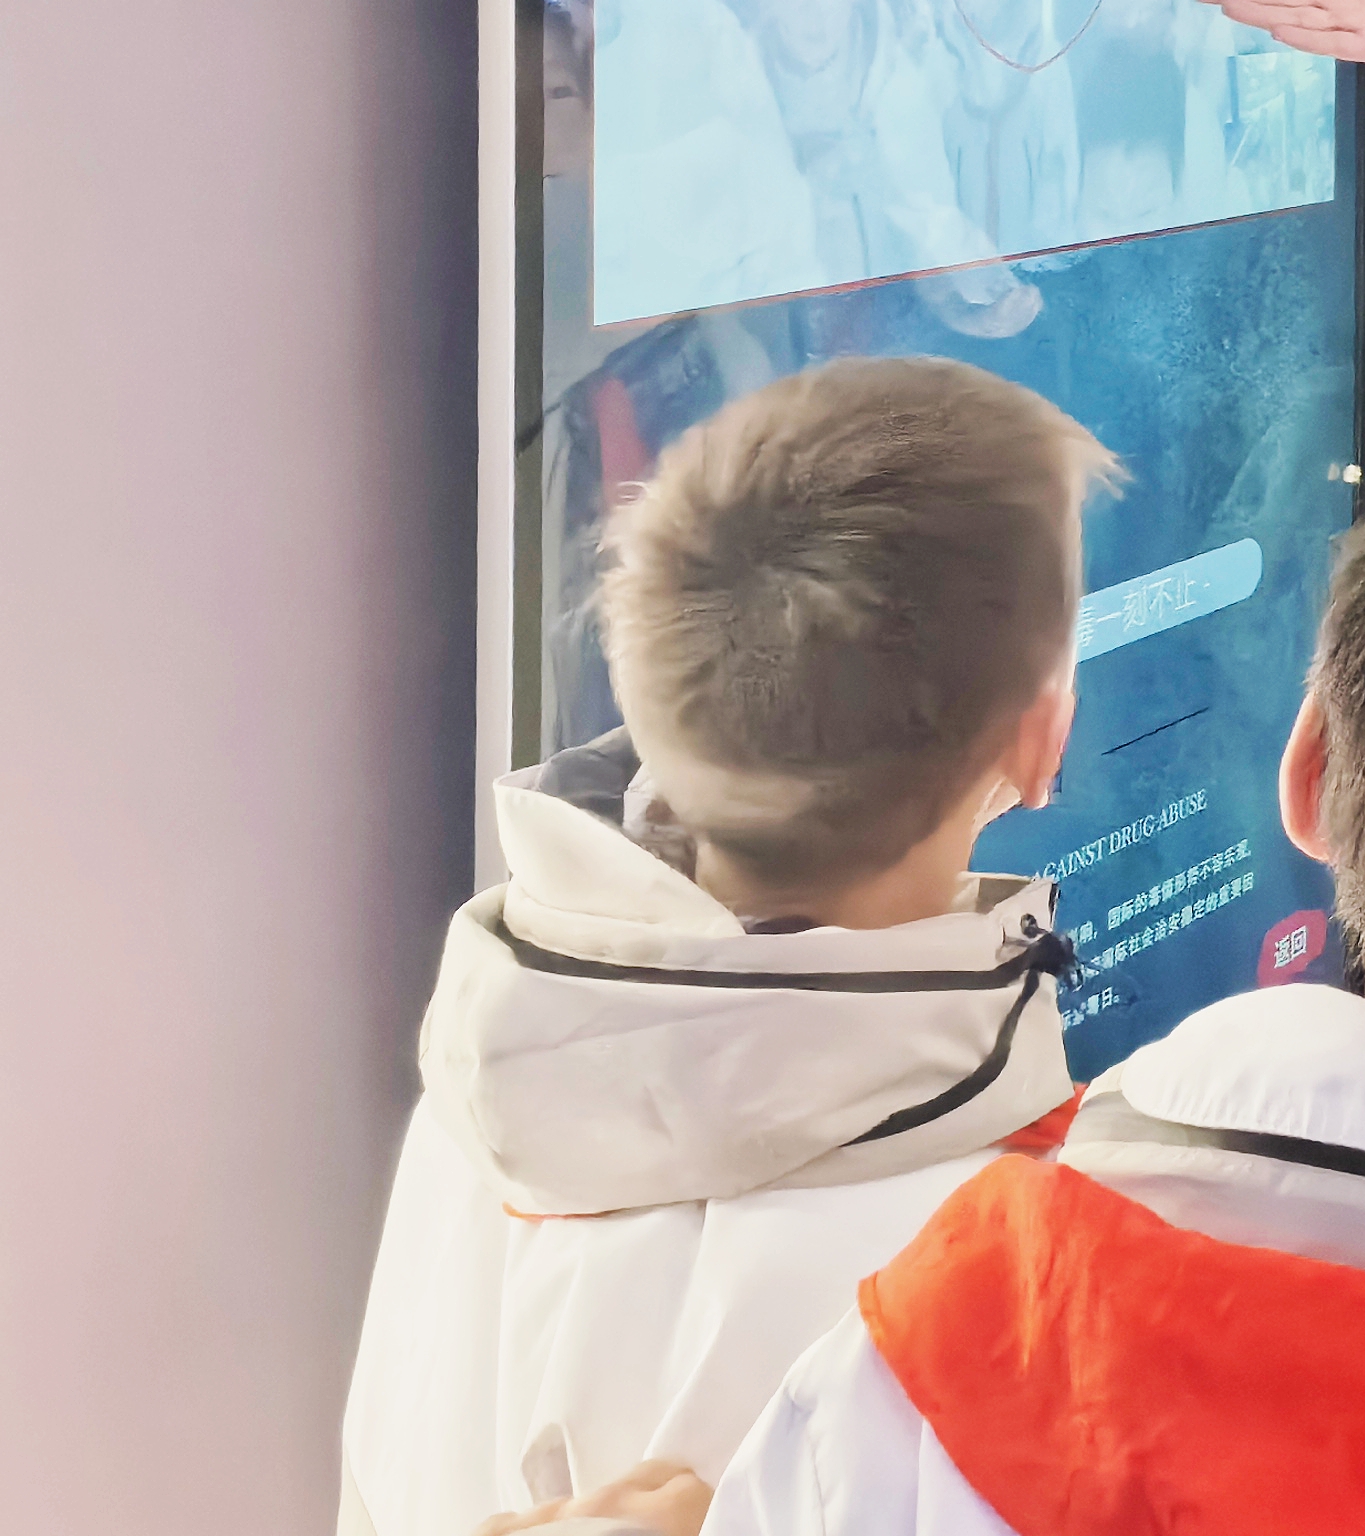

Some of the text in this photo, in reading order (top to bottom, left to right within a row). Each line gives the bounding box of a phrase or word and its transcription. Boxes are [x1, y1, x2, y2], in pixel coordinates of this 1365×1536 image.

[1108, 814, 1154, 855] DRUG
[1156, 788, 1208, 832] ABUSE
[1273, 925, 1307, 969] 返回
